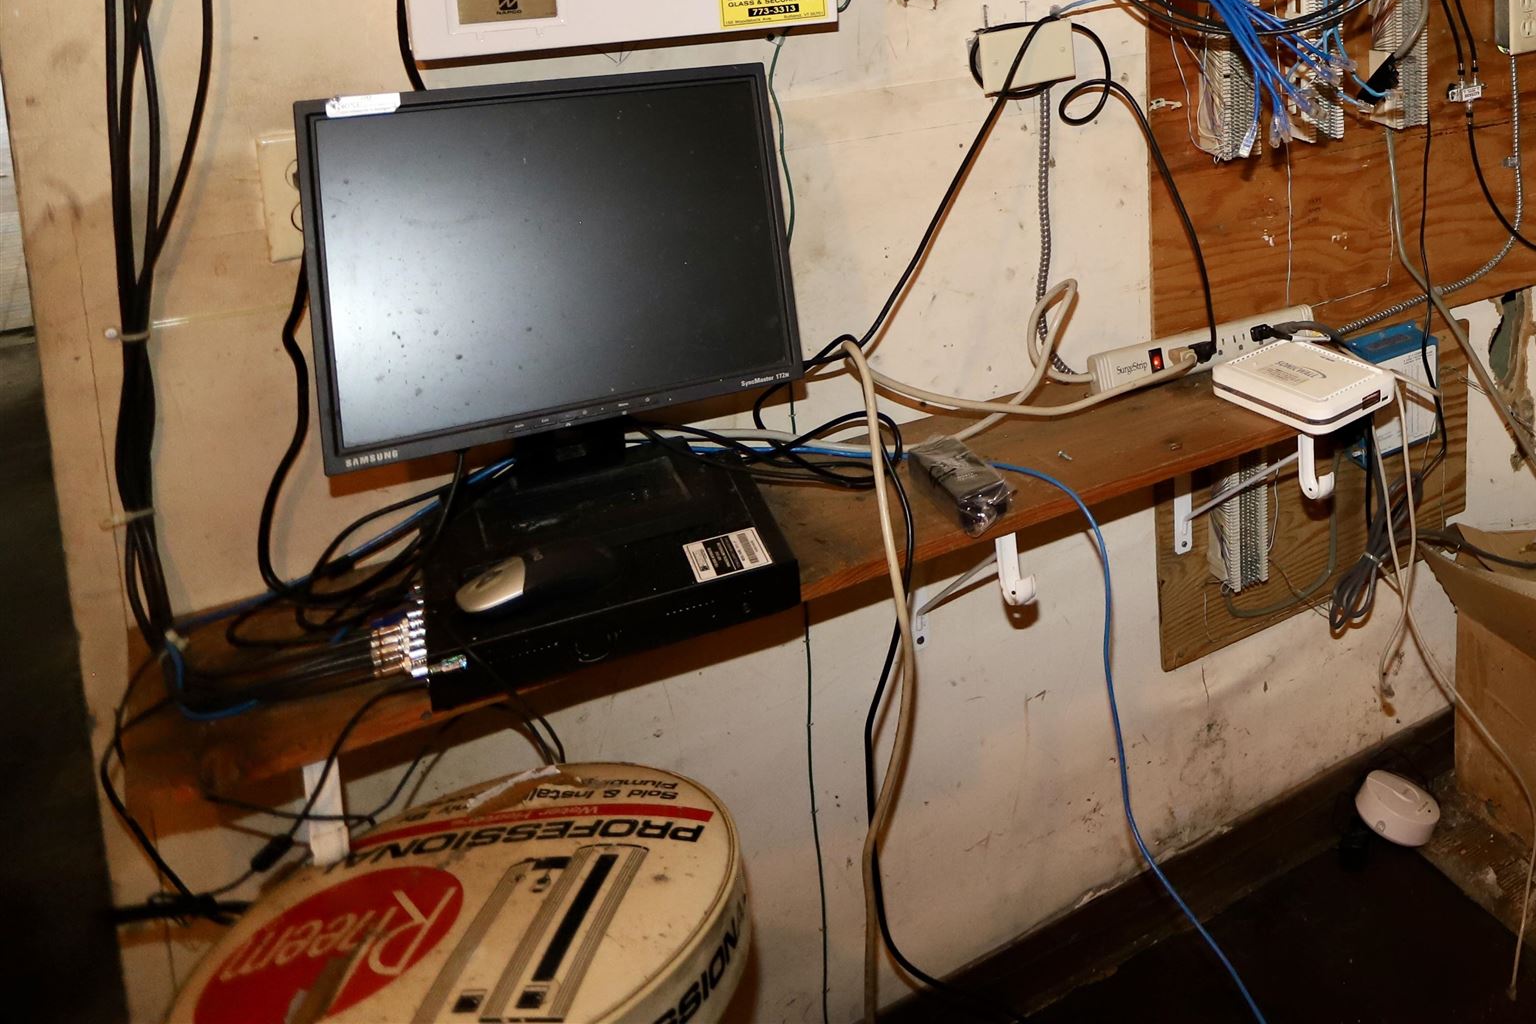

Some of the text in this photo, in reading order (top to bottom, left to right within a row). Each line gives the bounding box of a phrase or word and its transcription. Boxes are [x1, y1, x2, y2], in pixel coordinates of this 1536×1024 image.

[728, 0, 755, 8] GLASS
[752, 4, 797, 17] 773-3313
[1116, 362, 1149, 375] SurgeStrip
[741, 374, 775, 387] SyncMaster
[345, 449, 399, 468] SAMSUNG
[603, 789, 621, 800] &
[627, 790, 679, 801] Sold
[219, 886, 458, 1020] Rheem
